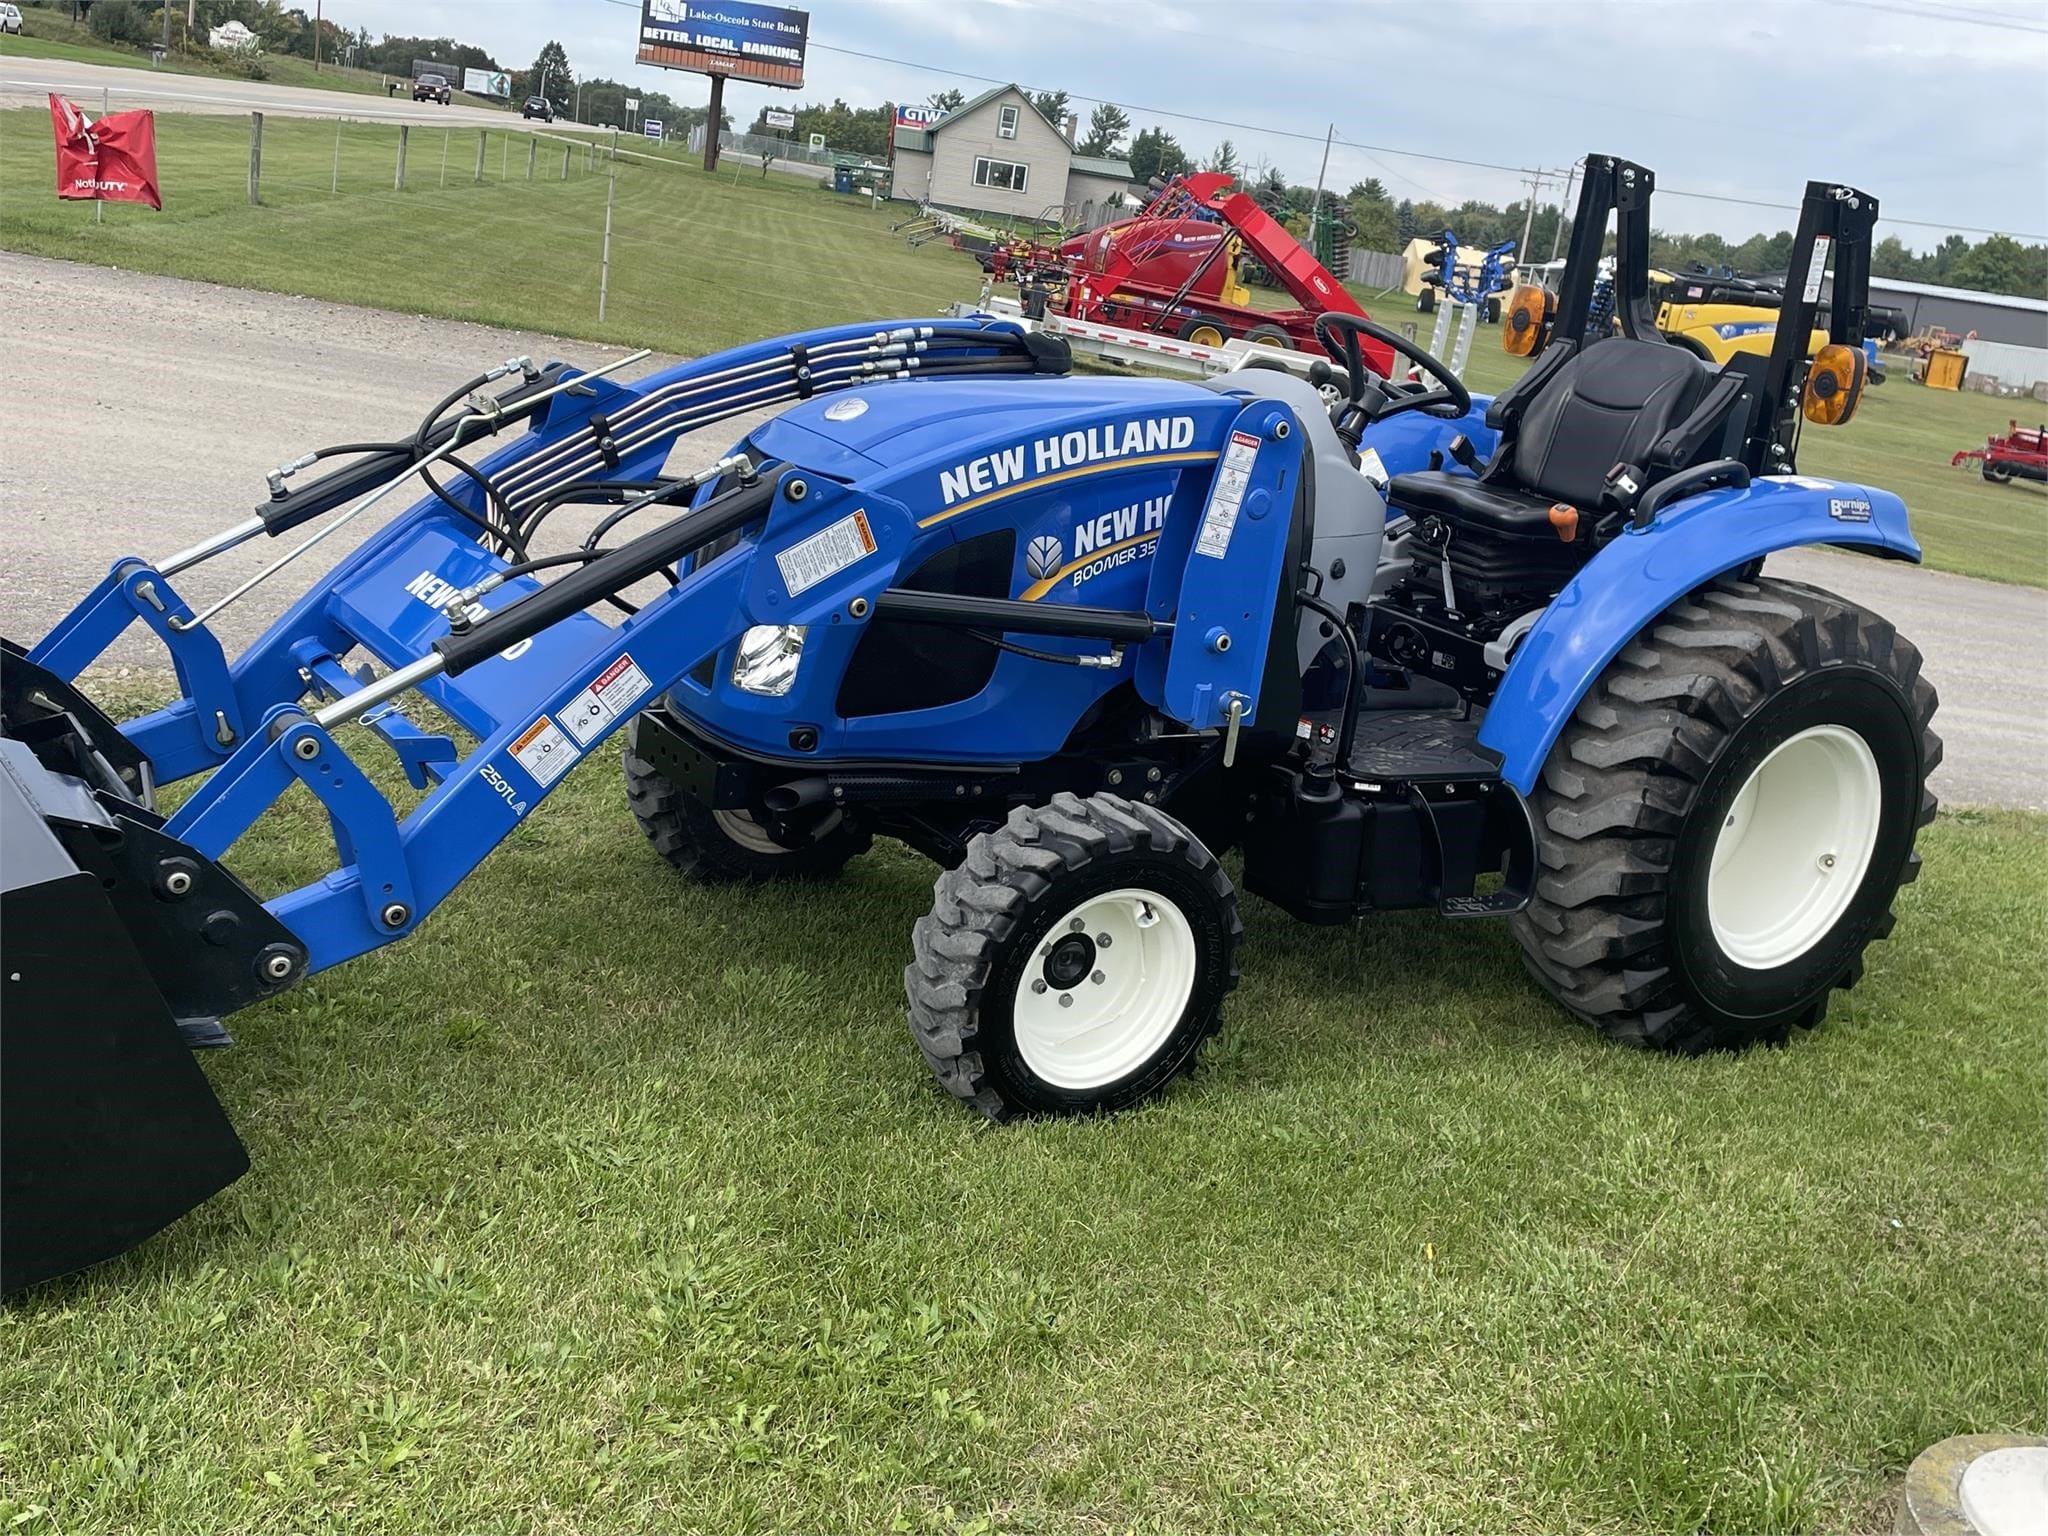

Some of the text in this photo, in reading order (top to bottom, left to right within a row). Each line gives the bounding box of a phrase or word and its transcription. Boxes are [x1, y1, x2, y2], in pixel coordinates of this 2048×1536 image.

[689, 8, 801, 34] Lake-Osceola State Bank
[643, 26, 802, 61] BETTER. LOCAL. BANKING.
[904, 107, 942, 123] GTW
[939, 416, 1195, 505] NEW HOLLAND
[1831, 497, 1871, 516] Burnips
[1074, 503, 1139, 558] NEW
[1073, 547, 1137, 587] BOOMER
[404, 570, 462, 609] NEW
[600, 659, 629, 686] DANGER
